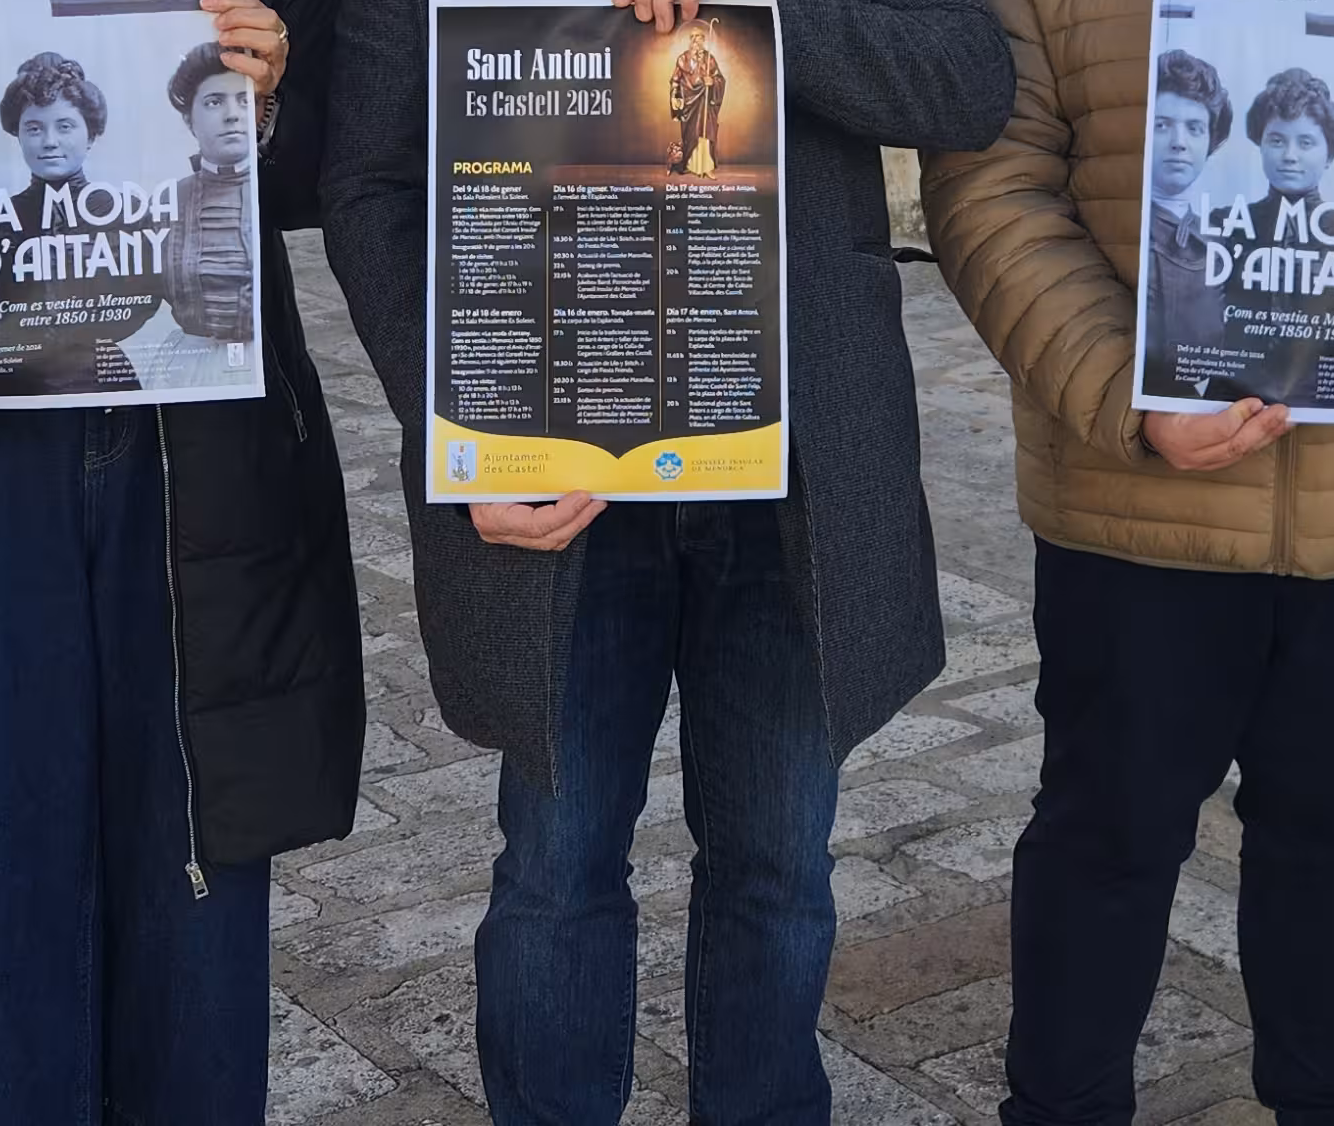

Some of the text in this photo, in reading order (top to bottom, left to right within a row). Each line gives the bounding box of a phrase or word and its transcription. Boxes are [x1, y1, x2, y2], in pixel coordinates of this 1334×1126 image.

[467, 47, 612, 81] Sant Antoni
[466, 89, 613, 117] Es Castell 2026
[453, 162, 533, 175] PROGRAMA
[453, 185, 465, 193] Del
[473, 185, 480, 193] al
[491, 185, 500, 193] de
[501, 186, 522, 194] gener
[577, 185, 586, 193] de
[679, 184, 688, 192] 17
[689, 184, 698, 192] de
[41, 178, 179, 230] MODA
[1200, 192, 1257, 240] LA
[30, 301, 43, 311] es
[45, 295, 83, 310] vestia
[86, 299, 95, 308] a
[97, 294, 152, 308] Menorca
[20, 308, 132, 327] entre 1850 i 1930
[452, 309, 465, 317] Del
[490, 309, 500, 317] de
[689, 308, 699, 316] de
[1224, 305, 1253, 323] Com
[1255, 311, 1267, 321] es
[1270, 310, 1309, 324] vestia
[1311, 315, 1320, 324] a
[1244, 325, 1276, 336] entre
[1279, 324, 1312, 338] 1850
[1315, 328, 1320, 340] i
[484, 453, 549, 464] Ajuntament
[484, 464, 546, 474] des Castell
